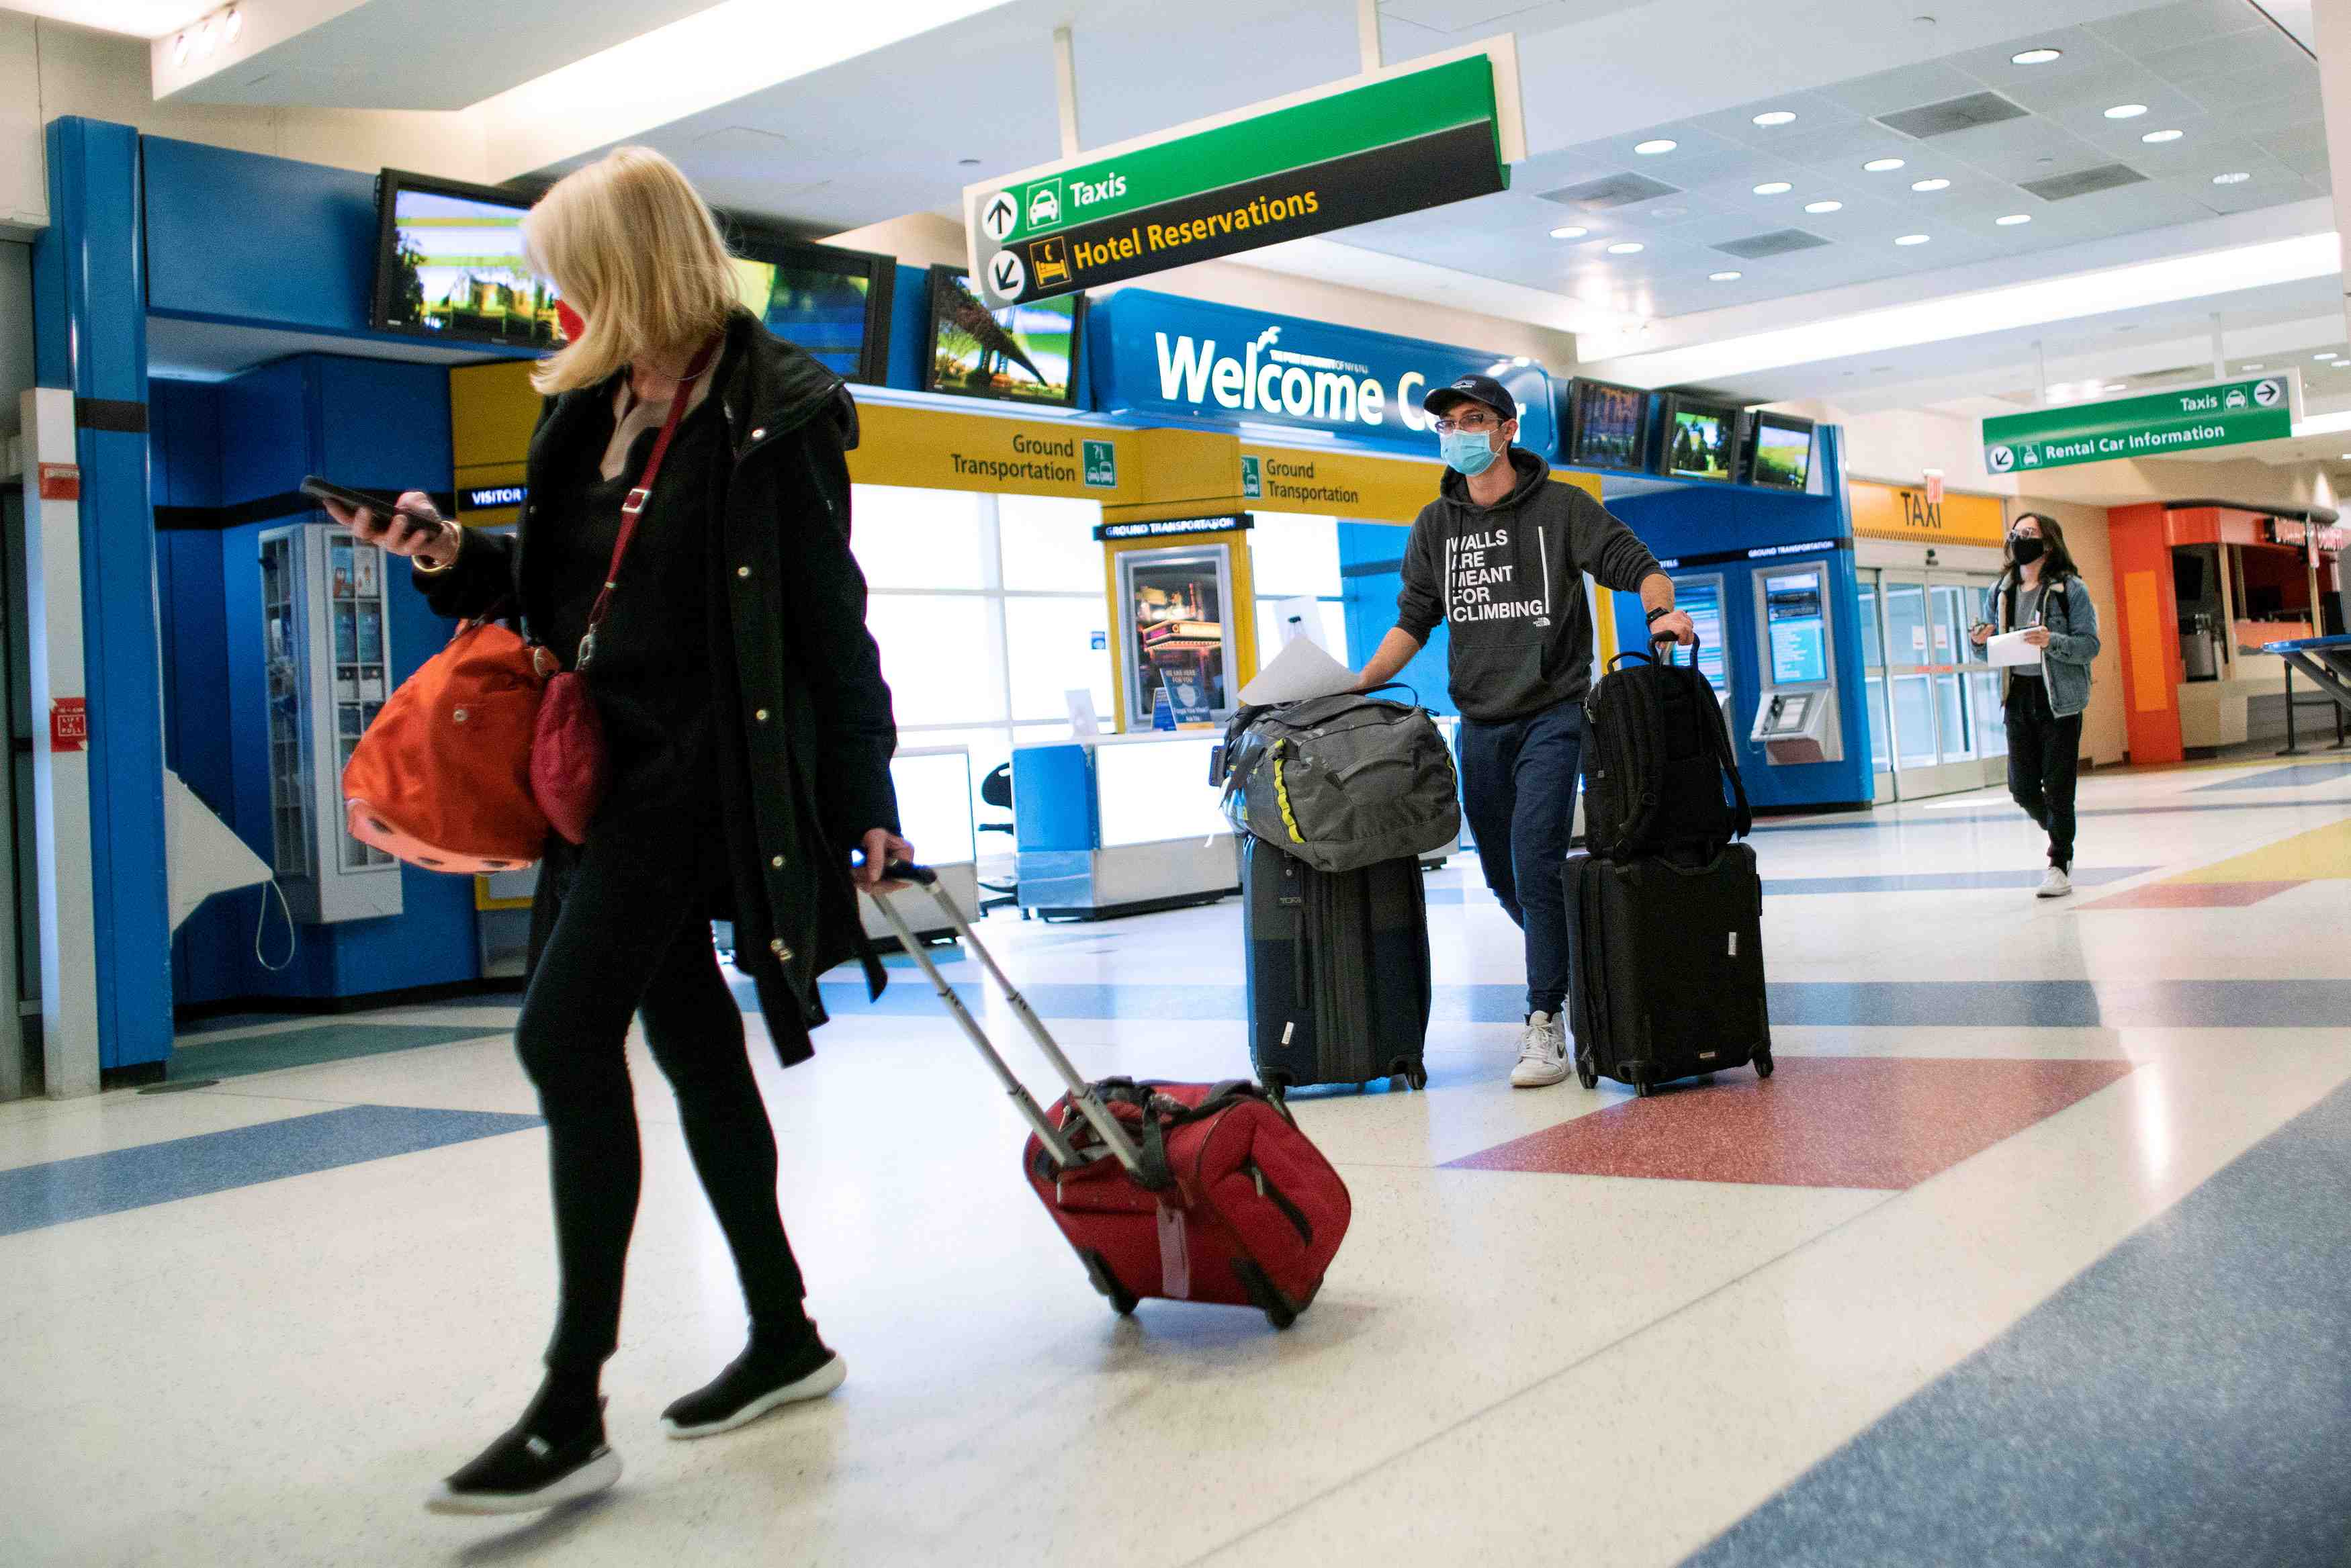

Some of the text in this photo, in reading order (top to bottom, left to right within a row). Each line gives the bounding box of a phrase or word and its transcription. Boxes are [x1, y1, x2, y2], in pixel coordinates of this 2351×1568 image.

[1069, 172, 1126, 207] Taxis
[1074, 191, 1319, 269] Hotel Reservations
[1155, 332, 1385, 426] Welcome
[2180, 394, 2219, 412] Taxis
[1012, 434, 1075, 457] Ground
[2045, 425, 2225, 460] Rental Car Information
[951, 453, 1075, 481] Transportation
[1266, 459, 1315, 479] Ground
[472, 488, 521, 506] VISITOR
[1267, 481, 1359, 504] Transportation
[1900, 491, 1942, 529] TAXI
[1106, 523, 1149, 537] GROUND
[1450, 528, 1509, 553] WALLS
[1452, 565, 1513, 588] MEANT
[1453, 599, 1544, 622] CLIMBING
